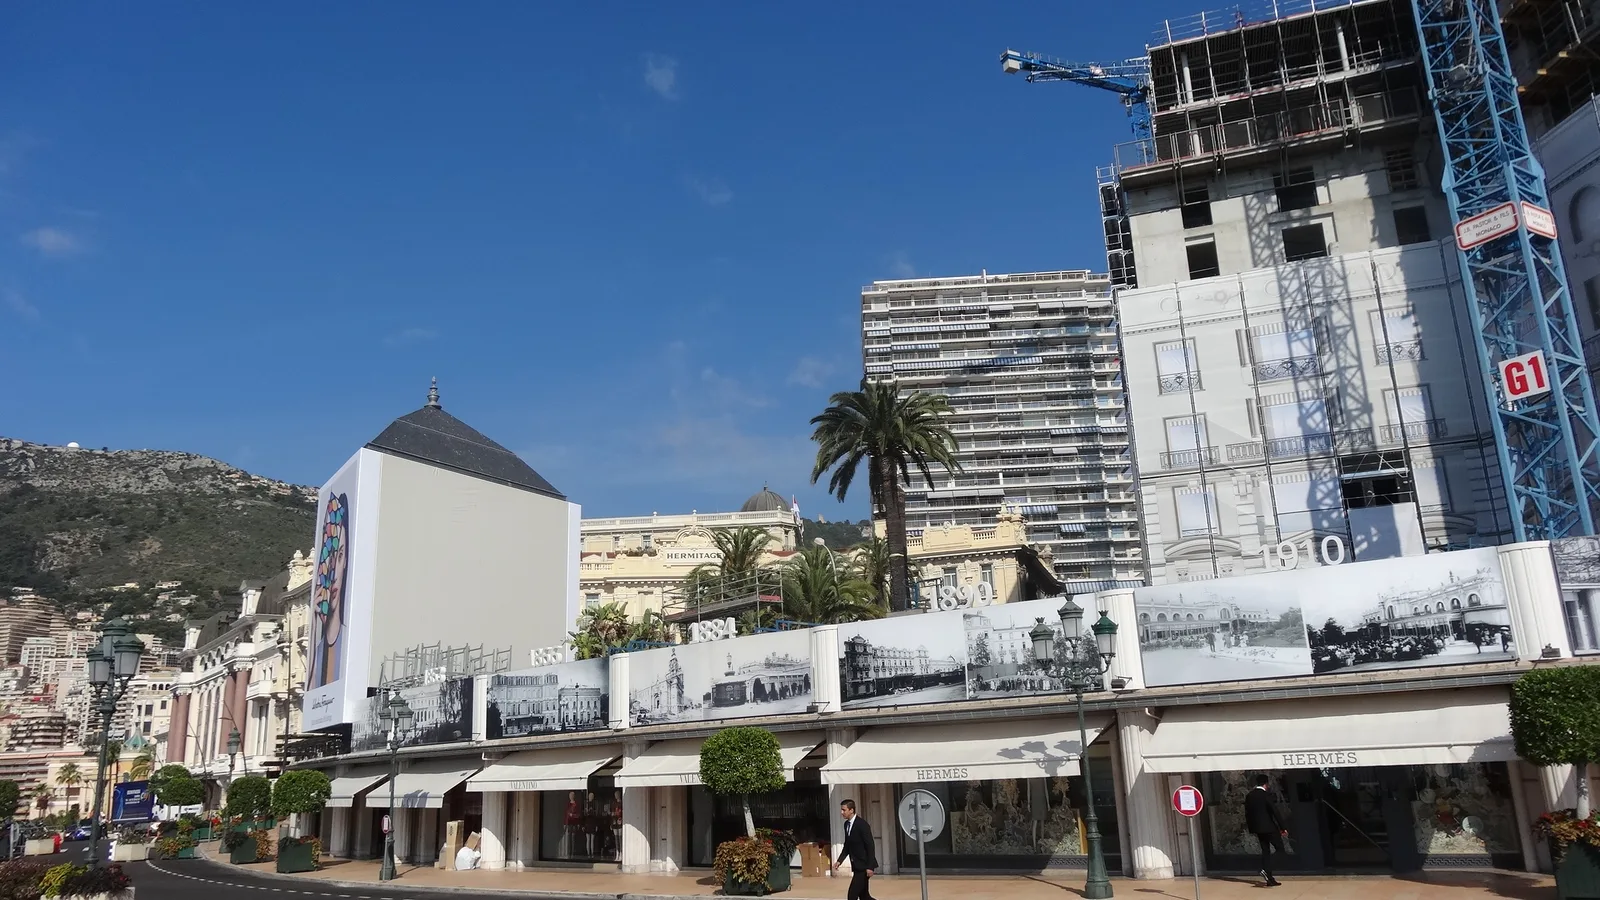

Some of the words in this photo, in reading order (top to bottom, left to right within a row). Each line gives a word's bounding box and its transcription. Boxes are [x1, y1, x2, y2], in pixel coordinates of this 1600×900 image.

[1472, 218, 1492, 230] PASTOR
[1475, 223, 1502, 237] MONACO
[1505, 356, 1545, 395] G1
[666, 552, 723, 560] HERMITAGE
[1258, 535, 1345, 571] 1910
[926, 580, 993, 613] 1890
[688, 616, 738, 644] 1884
